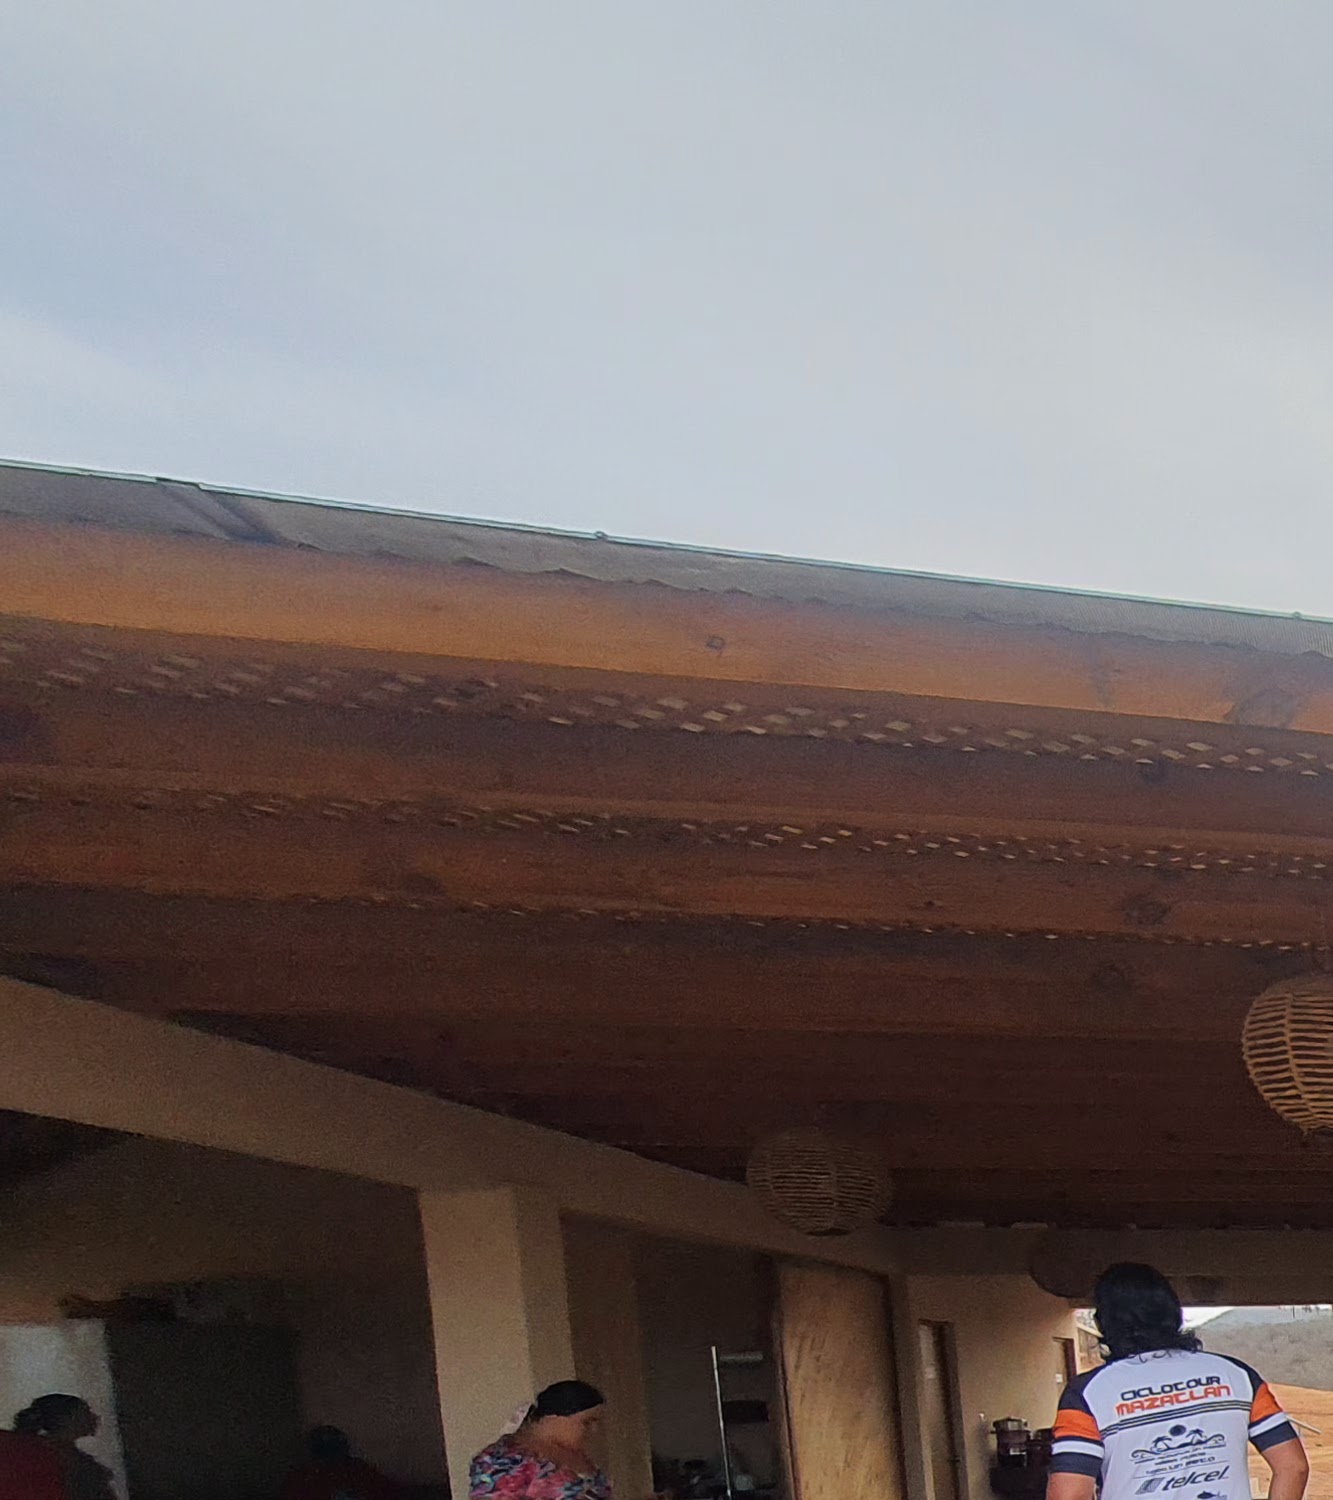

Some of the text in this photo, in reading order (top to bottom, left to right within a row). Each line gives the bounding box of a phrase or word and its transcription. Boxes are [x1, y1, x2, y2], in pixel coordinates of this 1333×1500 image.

[1115, 1385, 1231, 1416] MAZATLAN
[1120, 1375, 1221, 1401] CICLOTOUR
[1161, 1465, 1230, 1491] telcel
